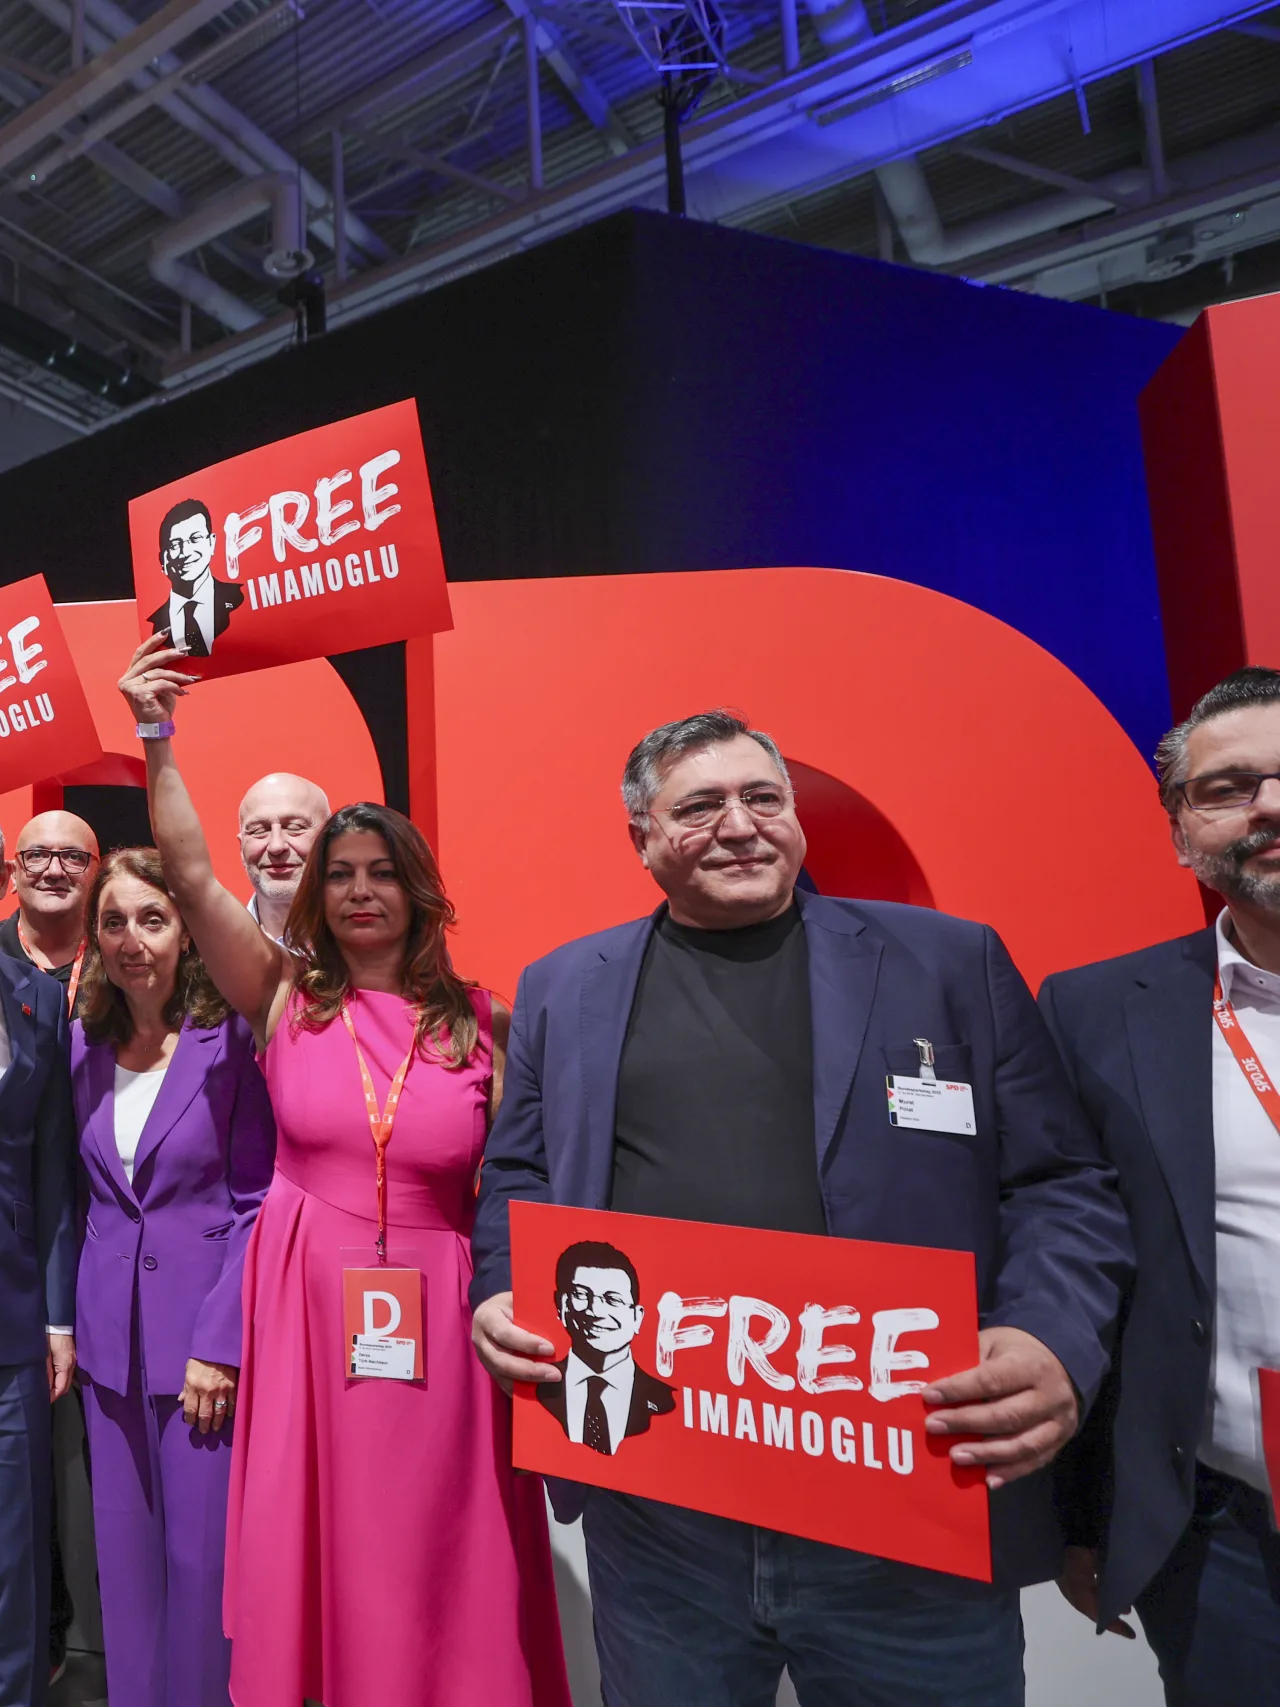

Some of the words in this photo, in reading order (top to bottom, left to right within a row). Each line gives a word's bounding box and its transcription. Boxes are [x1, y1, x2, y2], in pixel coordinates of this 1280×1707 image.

[223, 449, 402, 579] FREE
[246, 543, 400, 611] IMAMOGLU
[1241, 1056, 1272, 1093] SPD.DE
[363, 1290, 402, 1337] D
[655, 1290, 940, 1403] FREE
[683, 1386, 914, 1475] IMAMOGLU
